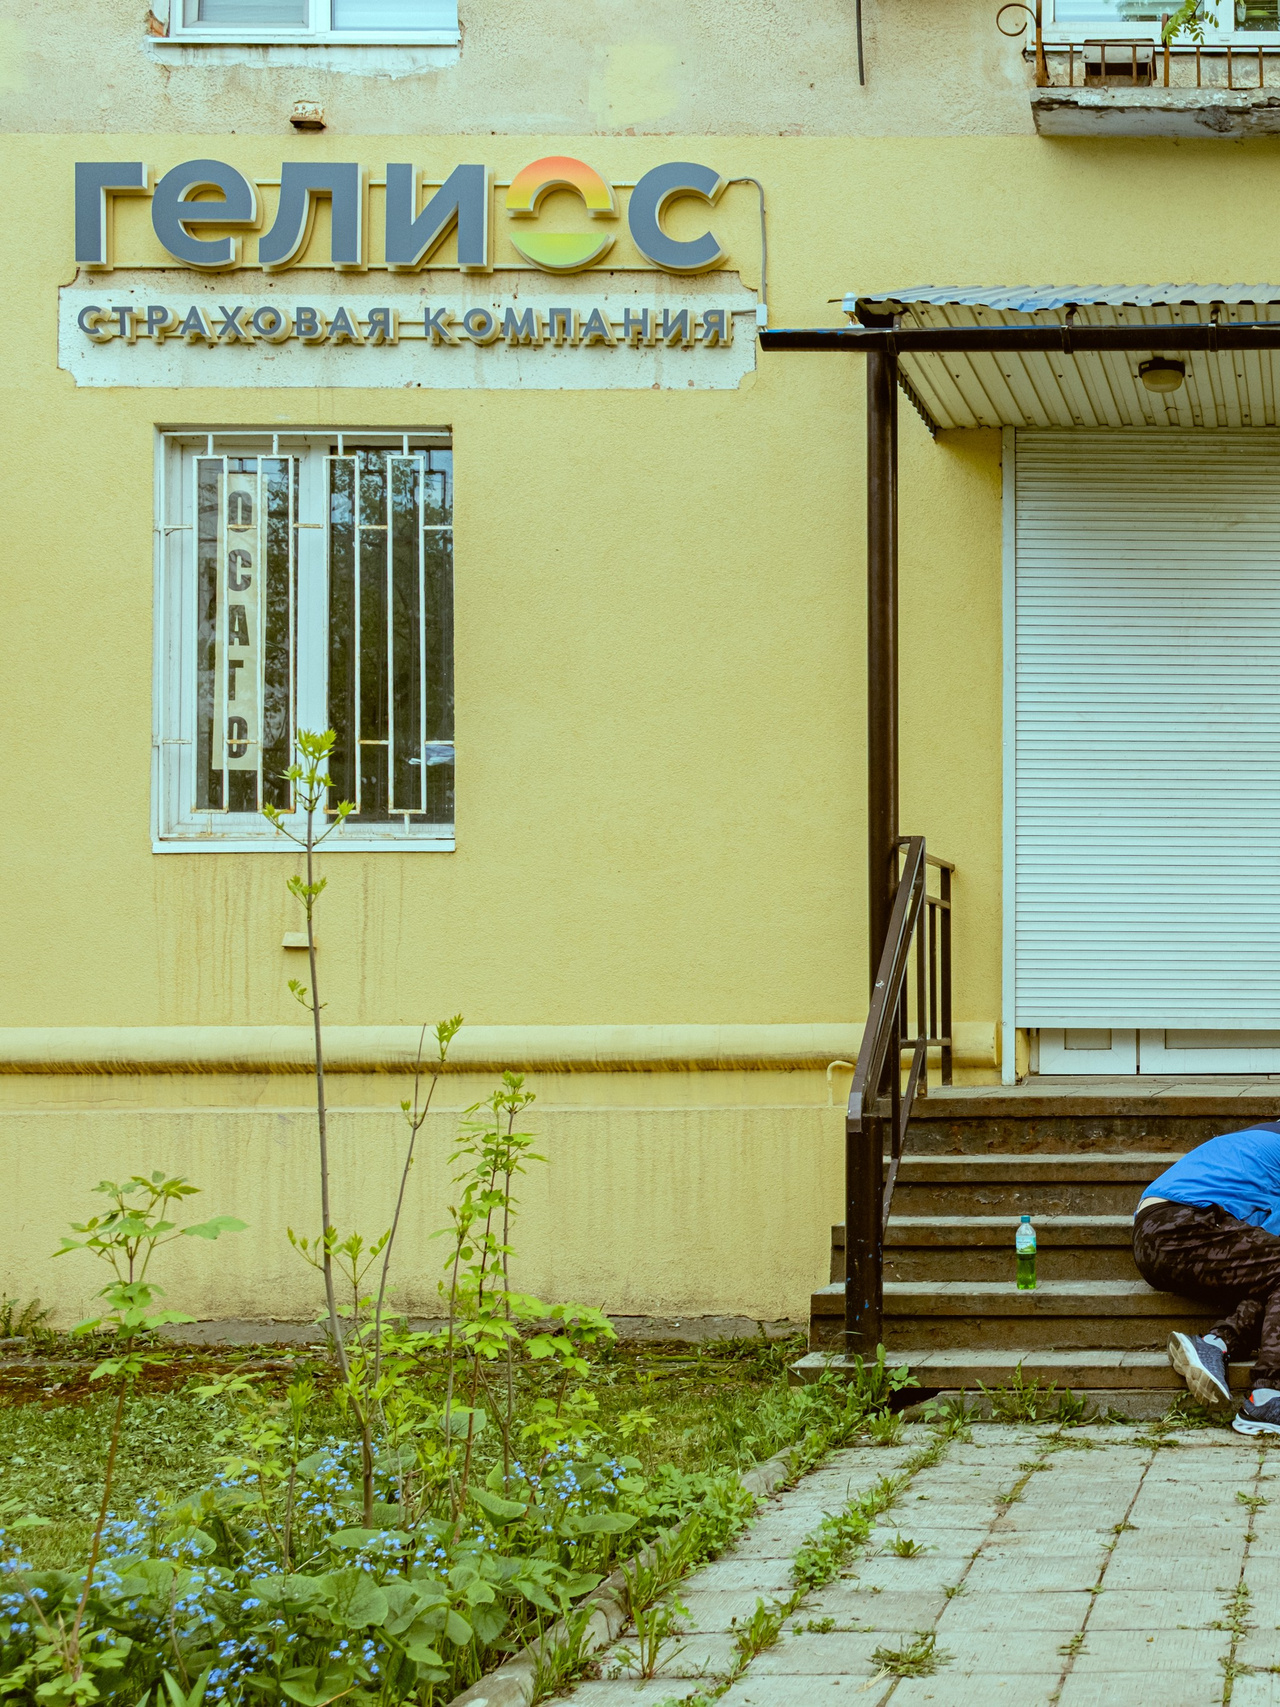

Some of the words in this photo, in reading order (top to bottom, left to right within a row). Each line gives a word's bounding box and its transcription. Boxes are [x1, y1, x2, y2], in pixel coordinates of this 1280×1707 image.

[77, 305, 396, 342] СТРАХОВАЯ
[424, 306, 732, 345] КОМПАНИЯ
[227, 489, 253, 760] ОСАГО
